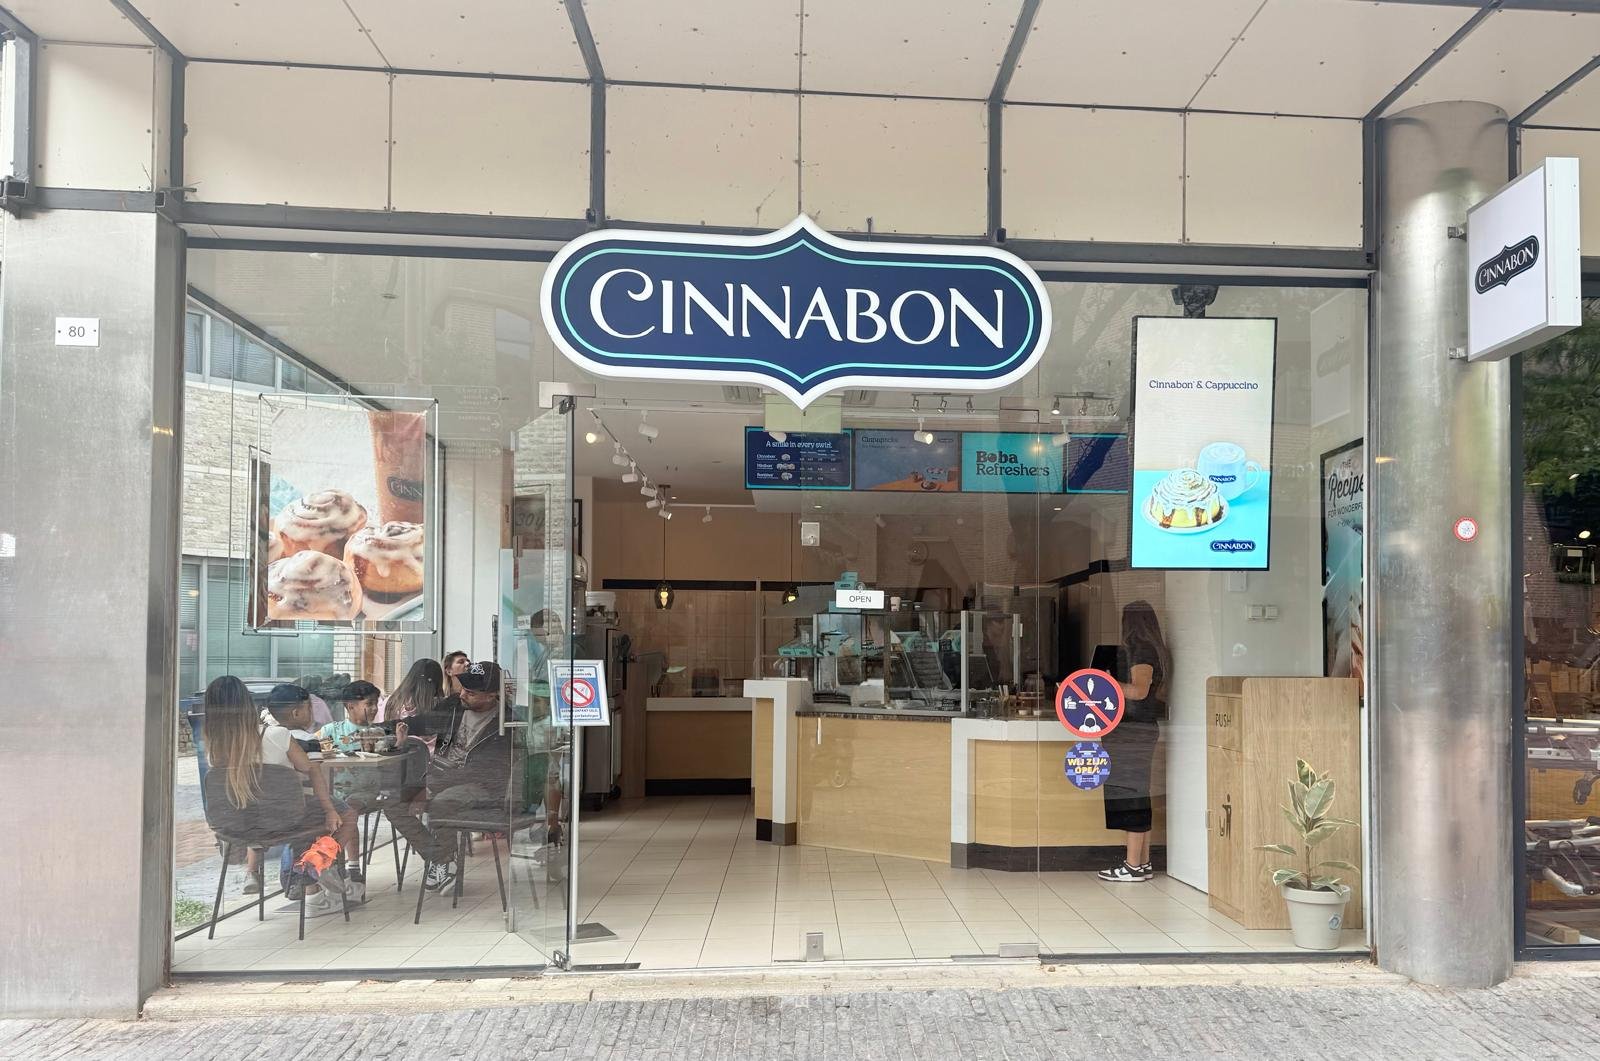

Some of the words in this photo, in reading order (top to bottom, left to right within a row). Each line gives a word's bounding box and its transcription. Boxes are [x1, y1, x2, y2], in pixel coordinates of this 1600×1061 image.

[1478, 243, 1534, 288] CINNABON
[589, 268, 1004, 349] CINNABON
[68, 325, 86, 338] 80
[1149, 380, 1193, 389] Cinnabon
[1196, 380, 1203, 389] &
[1205, 380, 1259, 391] Cappuccino
[976, 463, 1050, 477] Refreshers
[1212, 542, 1253, 550] CINNABON
[848, 595, 872, 603] OPEN
[1215, 713, 1232, 728] PUSH
